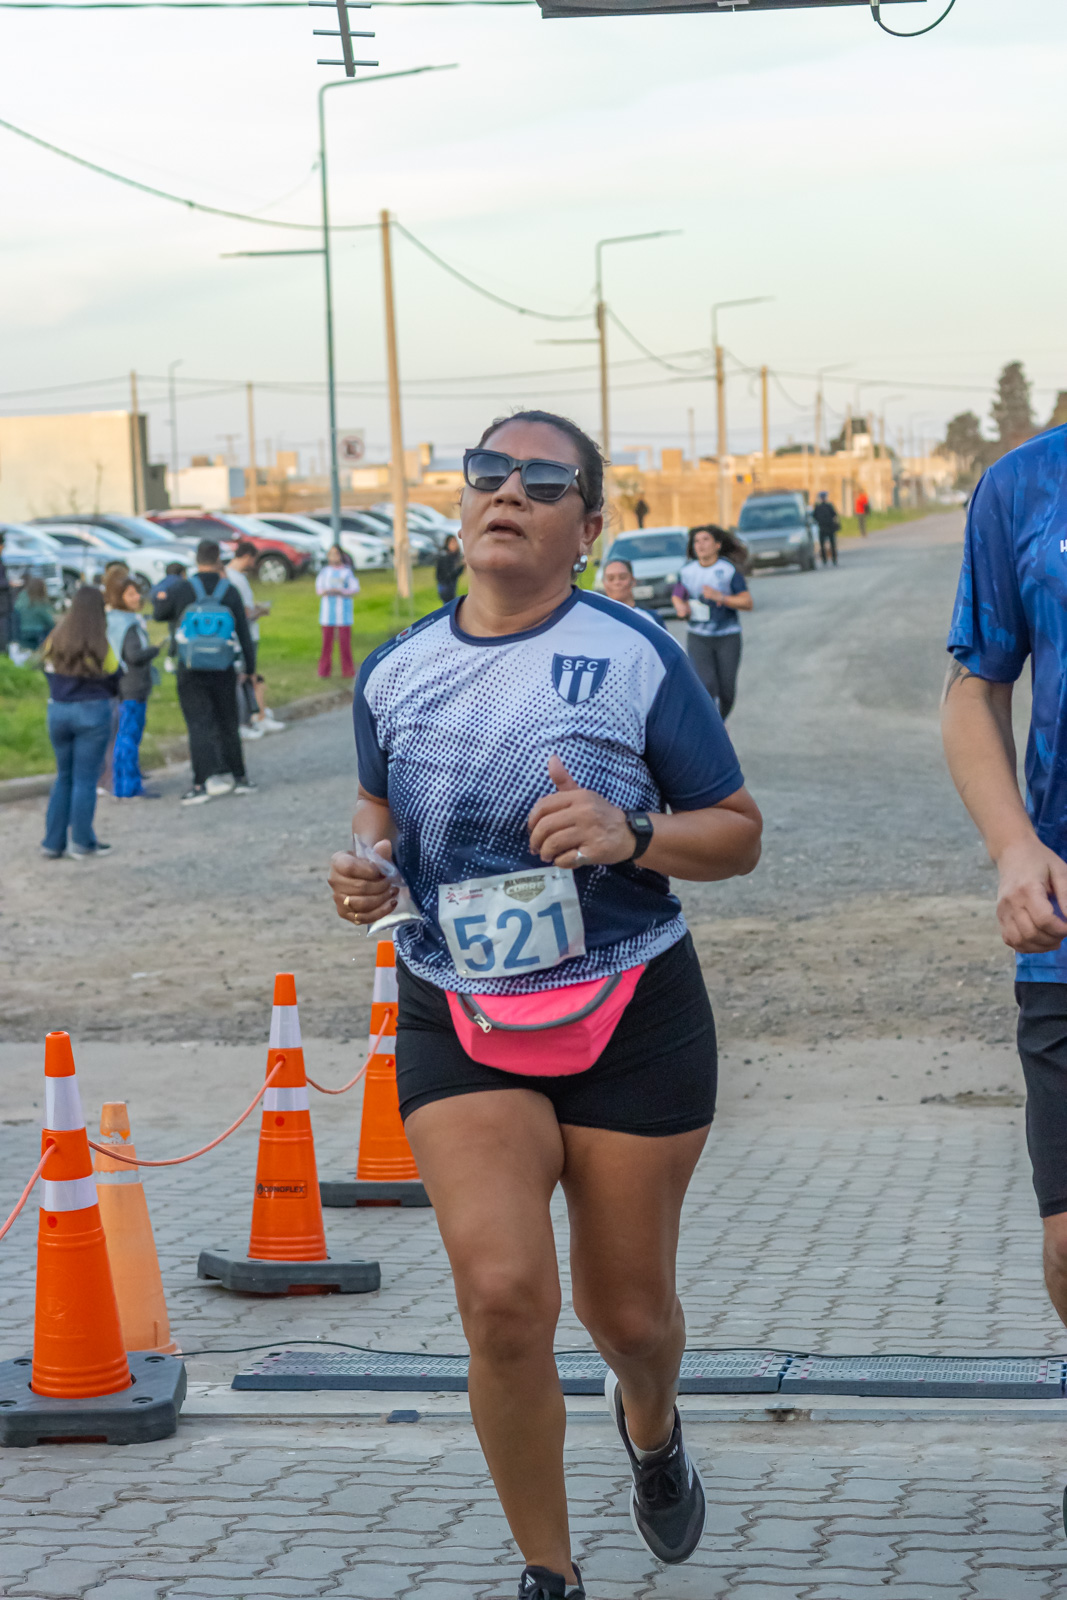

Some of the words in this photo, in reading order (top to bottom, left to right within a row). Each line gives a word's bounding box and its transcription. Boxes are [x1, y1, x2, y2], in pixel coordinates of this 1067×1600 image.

[562, 659, 599, 672] SFC
[504, 874, 546, 888] ALVAREZ
[453, 902, 570, 972] 521
